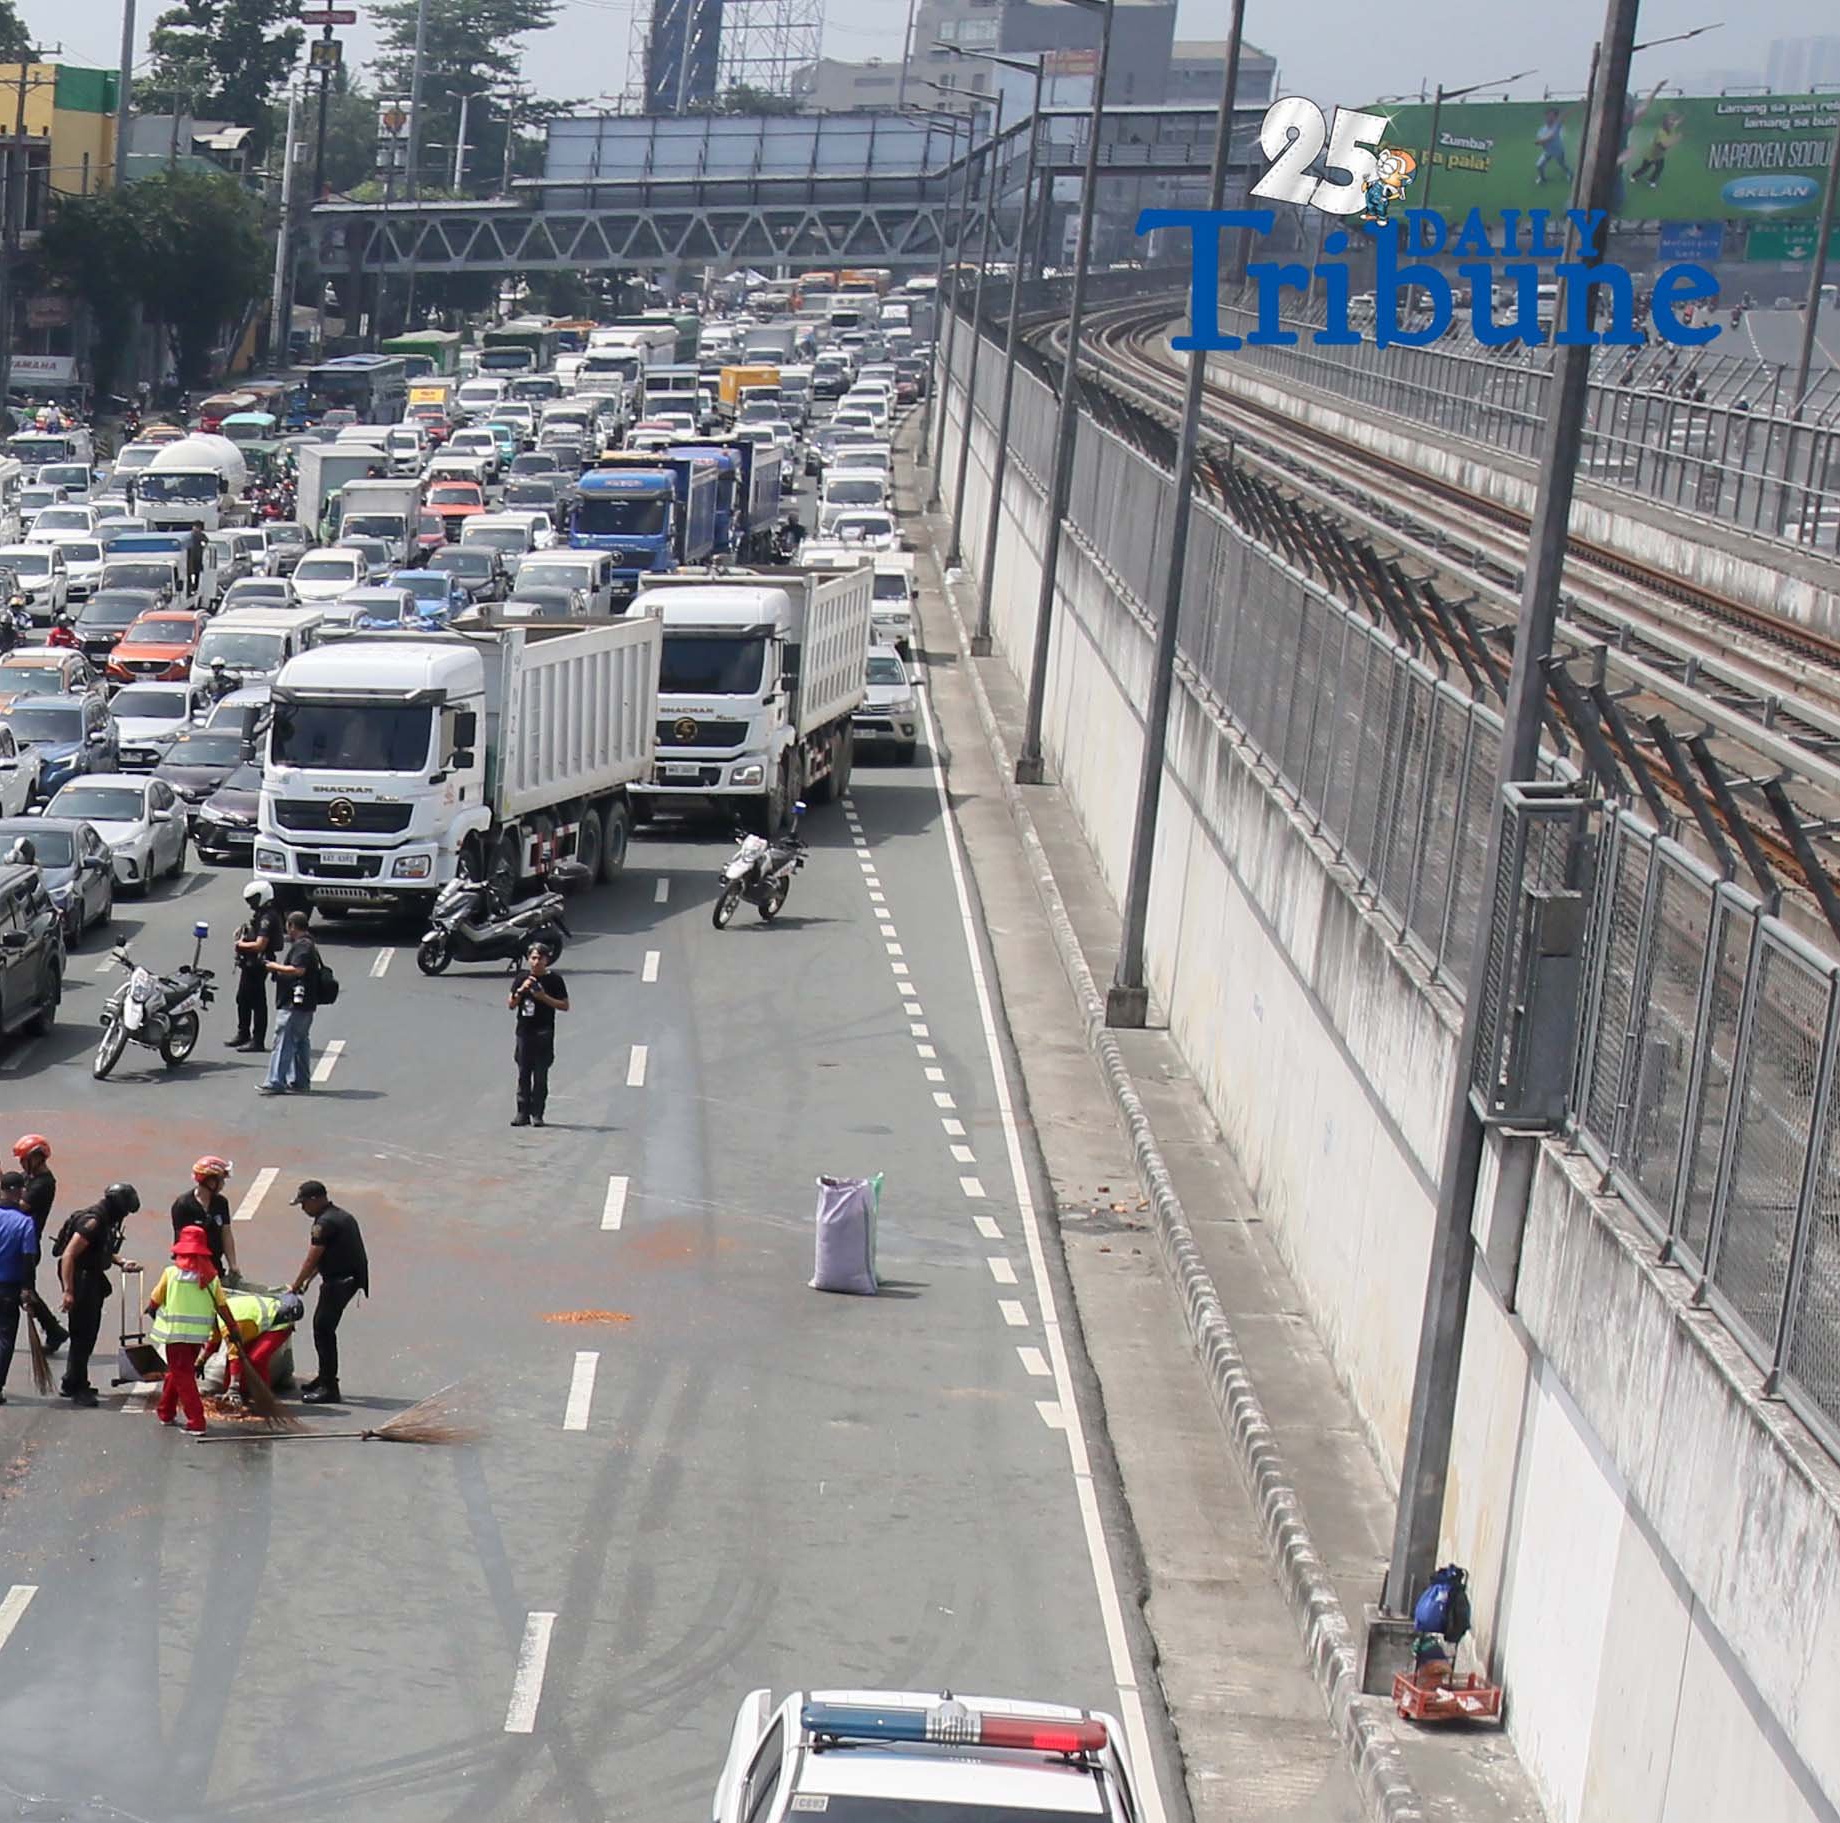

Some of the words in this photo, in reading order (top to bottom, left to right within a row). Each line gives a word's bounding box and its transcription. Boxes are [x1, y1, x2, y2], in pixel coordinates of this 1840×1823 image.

[1440, 132, 1494, 151] Zumba?
[1708, 142, 1784, 169] NAPROXEN
[1732, 186, 1811, 198] SKELAN
[312, 785, 373, 794] SHACMAN
